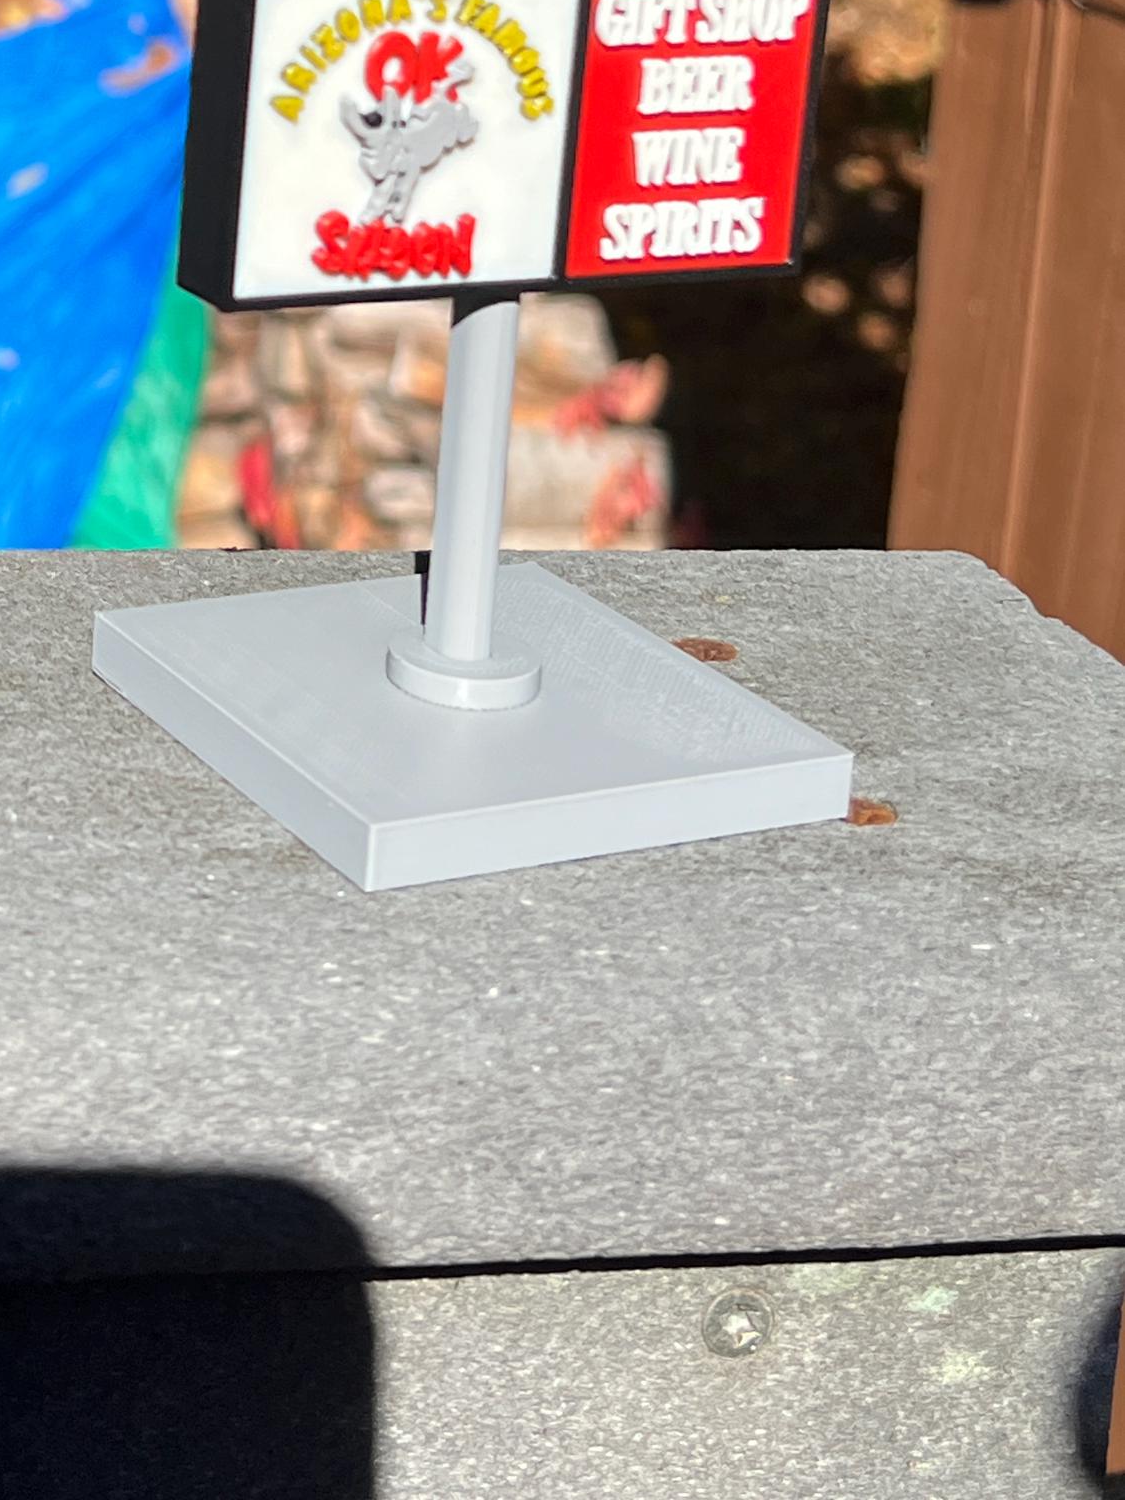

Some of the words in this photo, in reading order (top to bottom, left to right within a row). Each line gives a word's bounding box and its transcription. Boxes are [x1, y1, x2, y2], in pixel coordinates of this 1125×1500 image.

[365, 31, 464, 104] OK
[637, 55, 756, 116] BEER
[632, 127, 745, 188] WINE
[599, 197, 765, 261] SPIRITS
